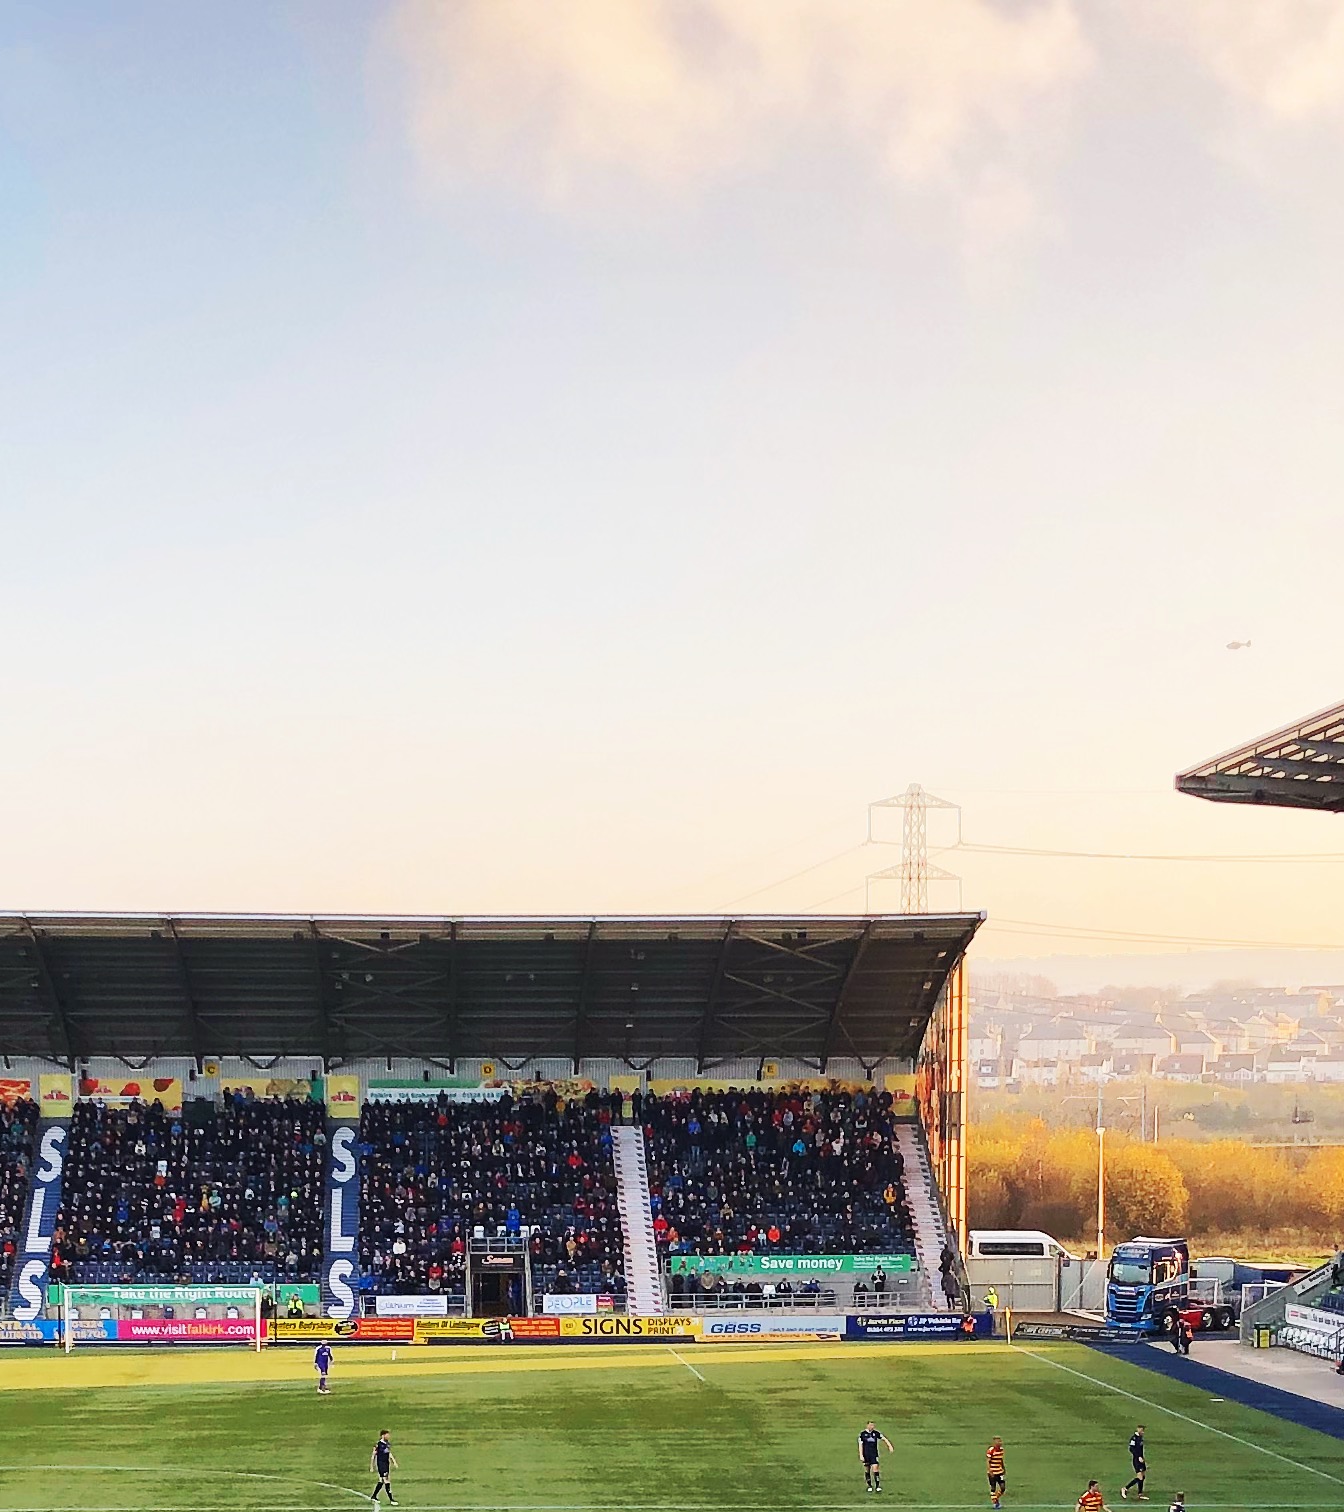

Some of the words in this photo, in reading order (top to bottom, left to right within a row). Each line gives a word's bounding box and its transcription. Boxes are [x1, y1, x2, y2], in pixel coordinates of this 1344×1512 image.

[760, 1256, 795, 1270] Save
[797, 1257, 844, 1271] money
[113, 1287, 145, 1299] Take
[149, 1287, 173, 1299] the
[174, 1287, 213, 1301] Right
[214, 1287, 256, 1299] Route
[547, 1296, 592, 1309] PEOPLE
[131, 1323, 255, 1336] www.visitfalkirk.com
[581, 1318, 643, 1335] SIGNS
[647, 1317, 692, 1327] DISPLAYS
[647, 1326, 676, 1335] PRINT
